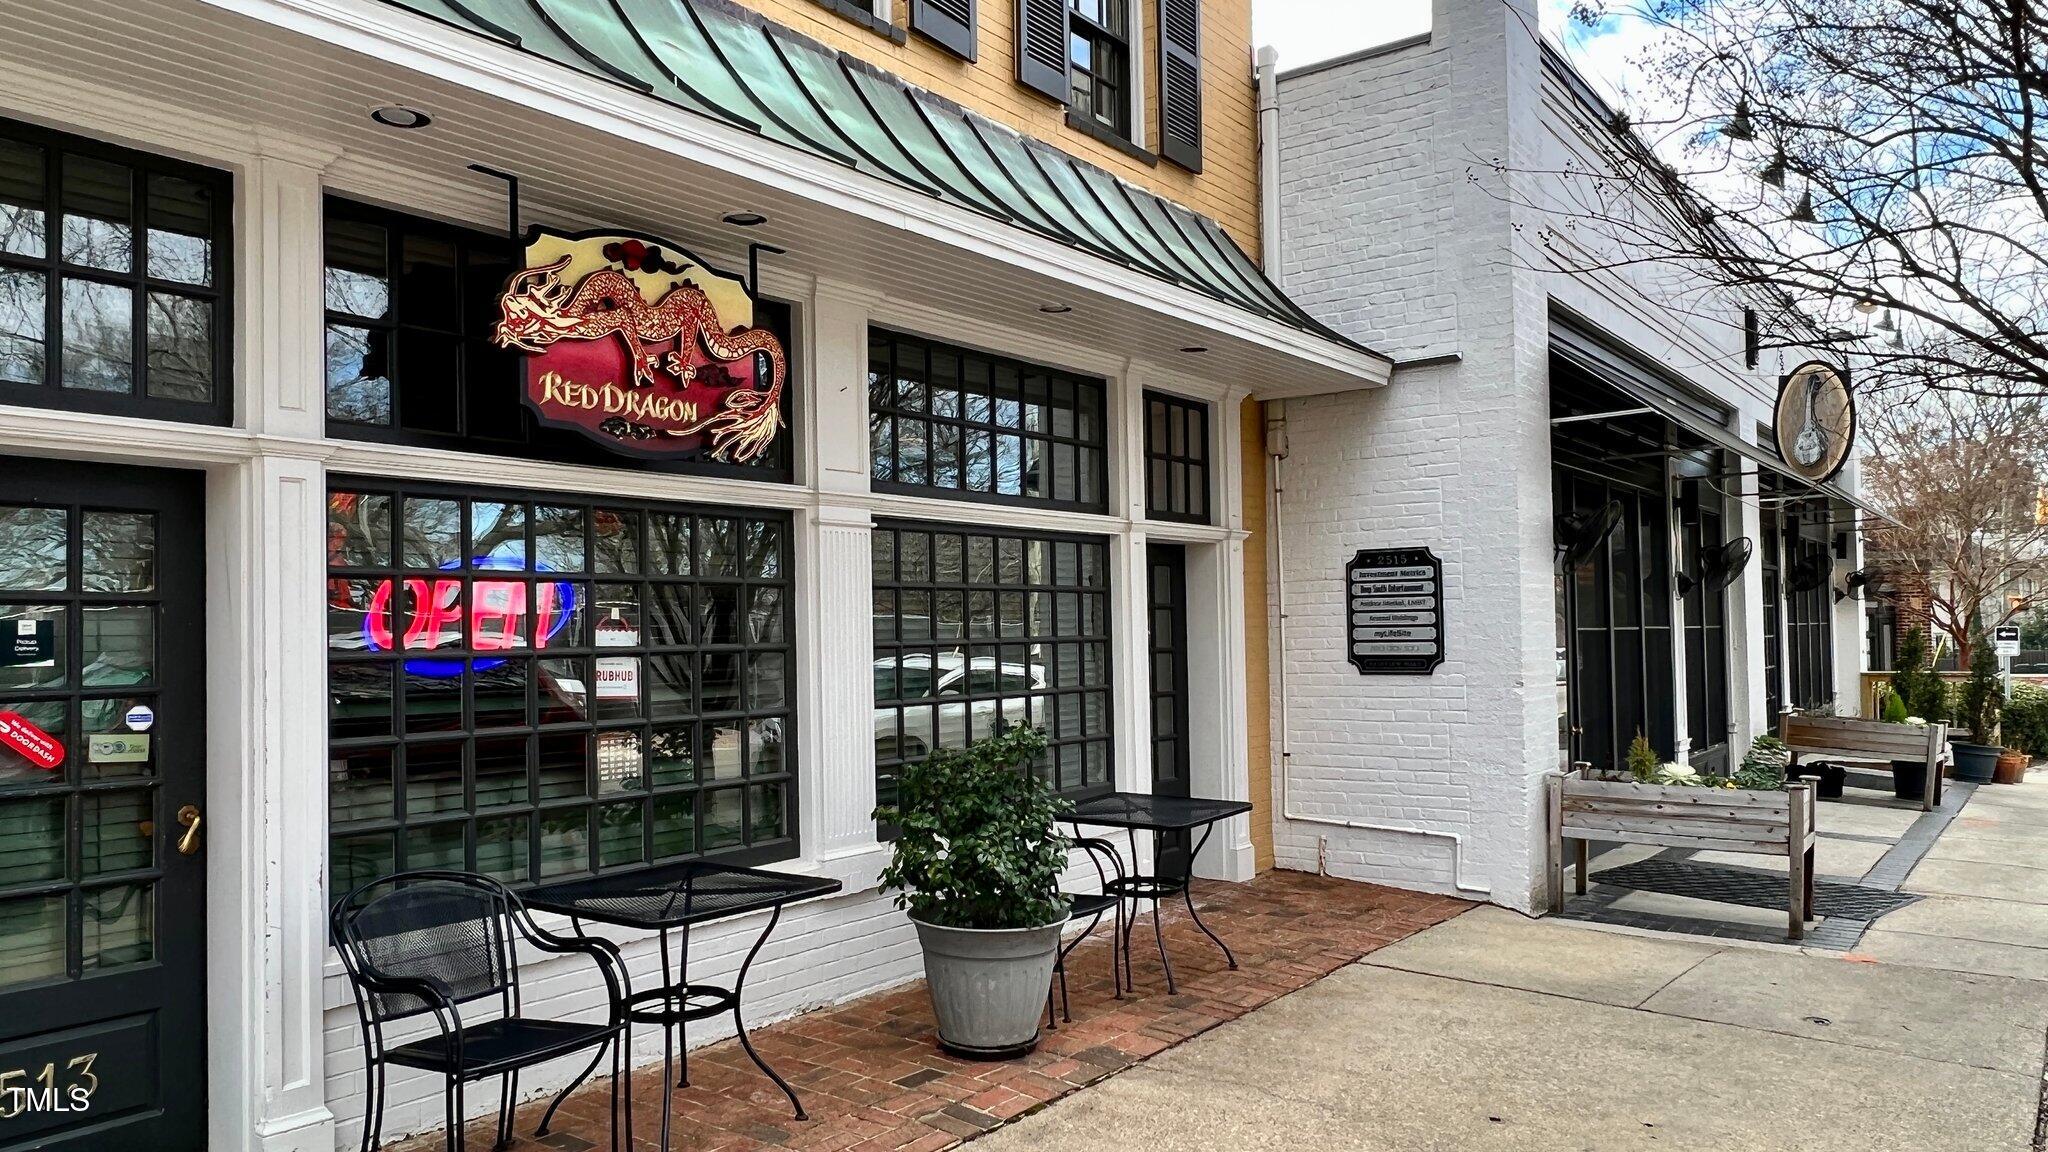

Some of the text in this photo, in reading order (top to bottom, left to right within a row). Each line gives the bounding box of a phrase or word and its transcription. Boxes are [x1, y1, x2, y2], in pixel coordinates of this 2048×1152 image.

[538, 370, 698, 424] RED DRAGON
[1377, 554, 1407, 565] 2515
[1359, 570, 1398, 578] Investment
[1373, 584, 1387, 593] South
[370, 579, 555, 650] OPEN
[10, 730, 56, 763] DOORDASH
